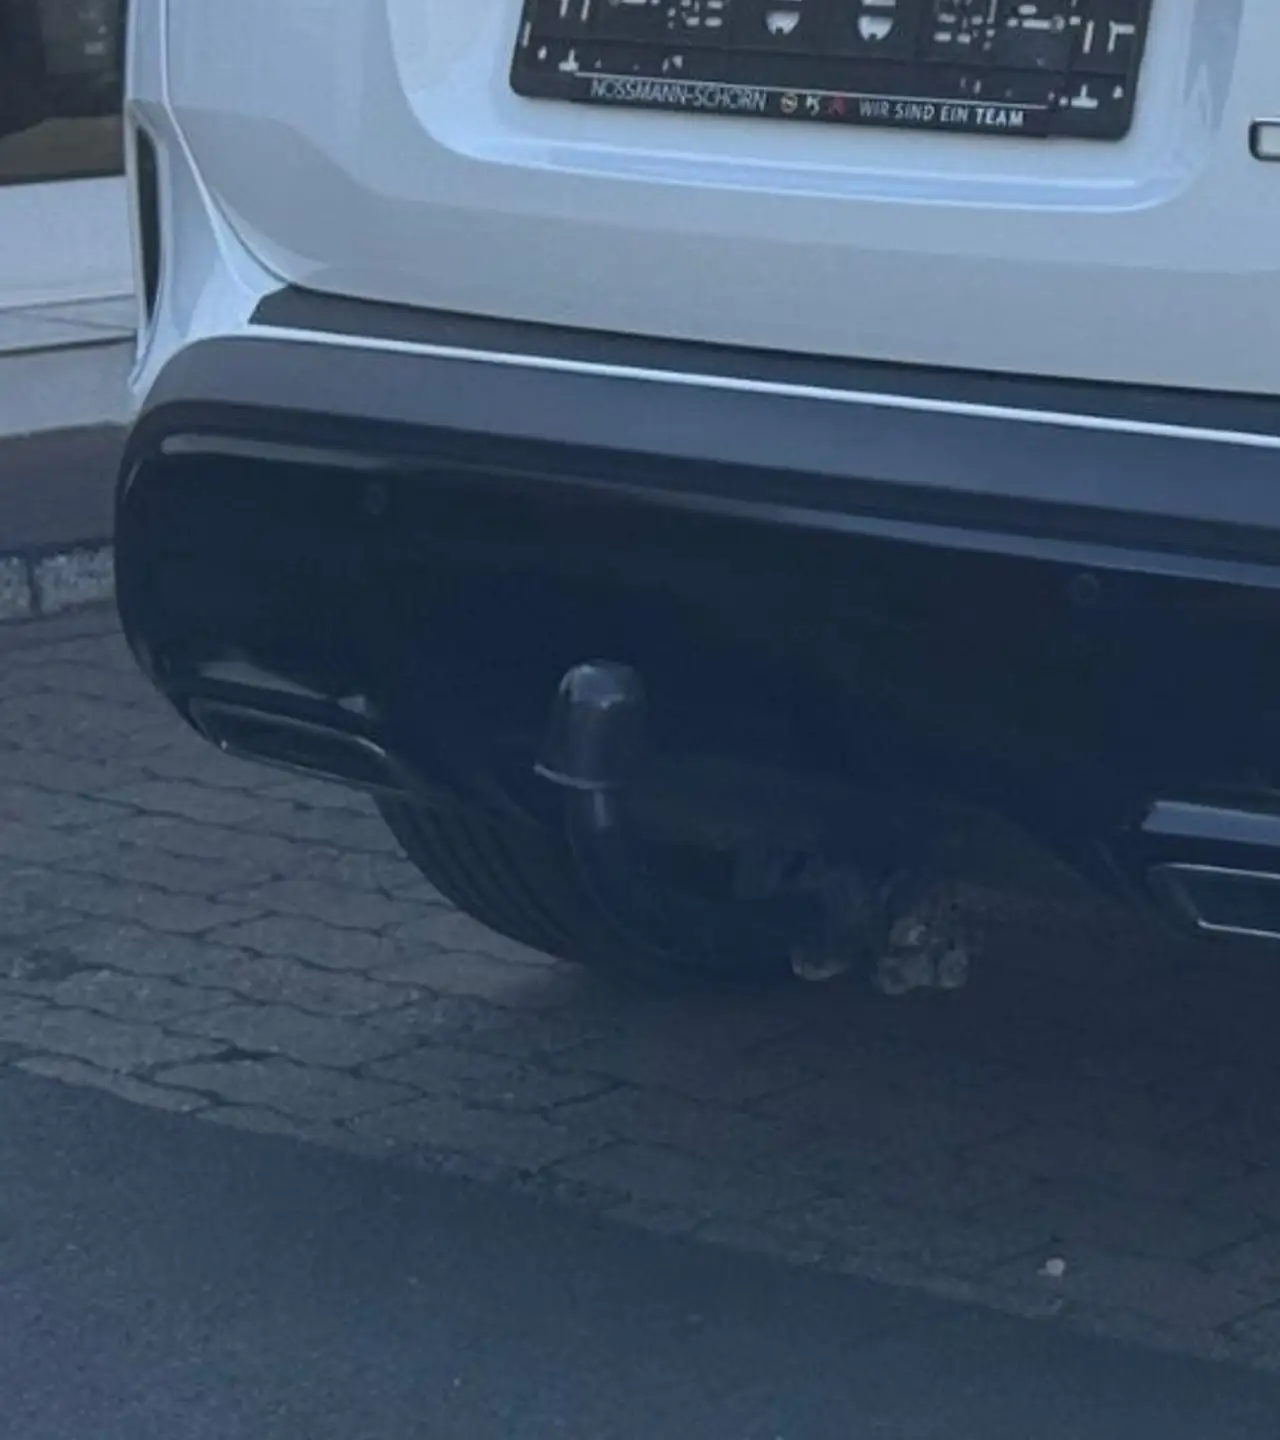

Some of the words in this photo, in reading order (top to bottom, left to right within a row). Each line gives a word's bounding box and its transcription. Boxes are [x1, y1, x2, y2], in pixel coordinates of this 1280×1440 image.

[859, 98, 889, 118] WIR
[894, 101, 935, 122] SIND
[940, 105, 969, 125] EIN
[975, 107, 1025, 128] TEAM
